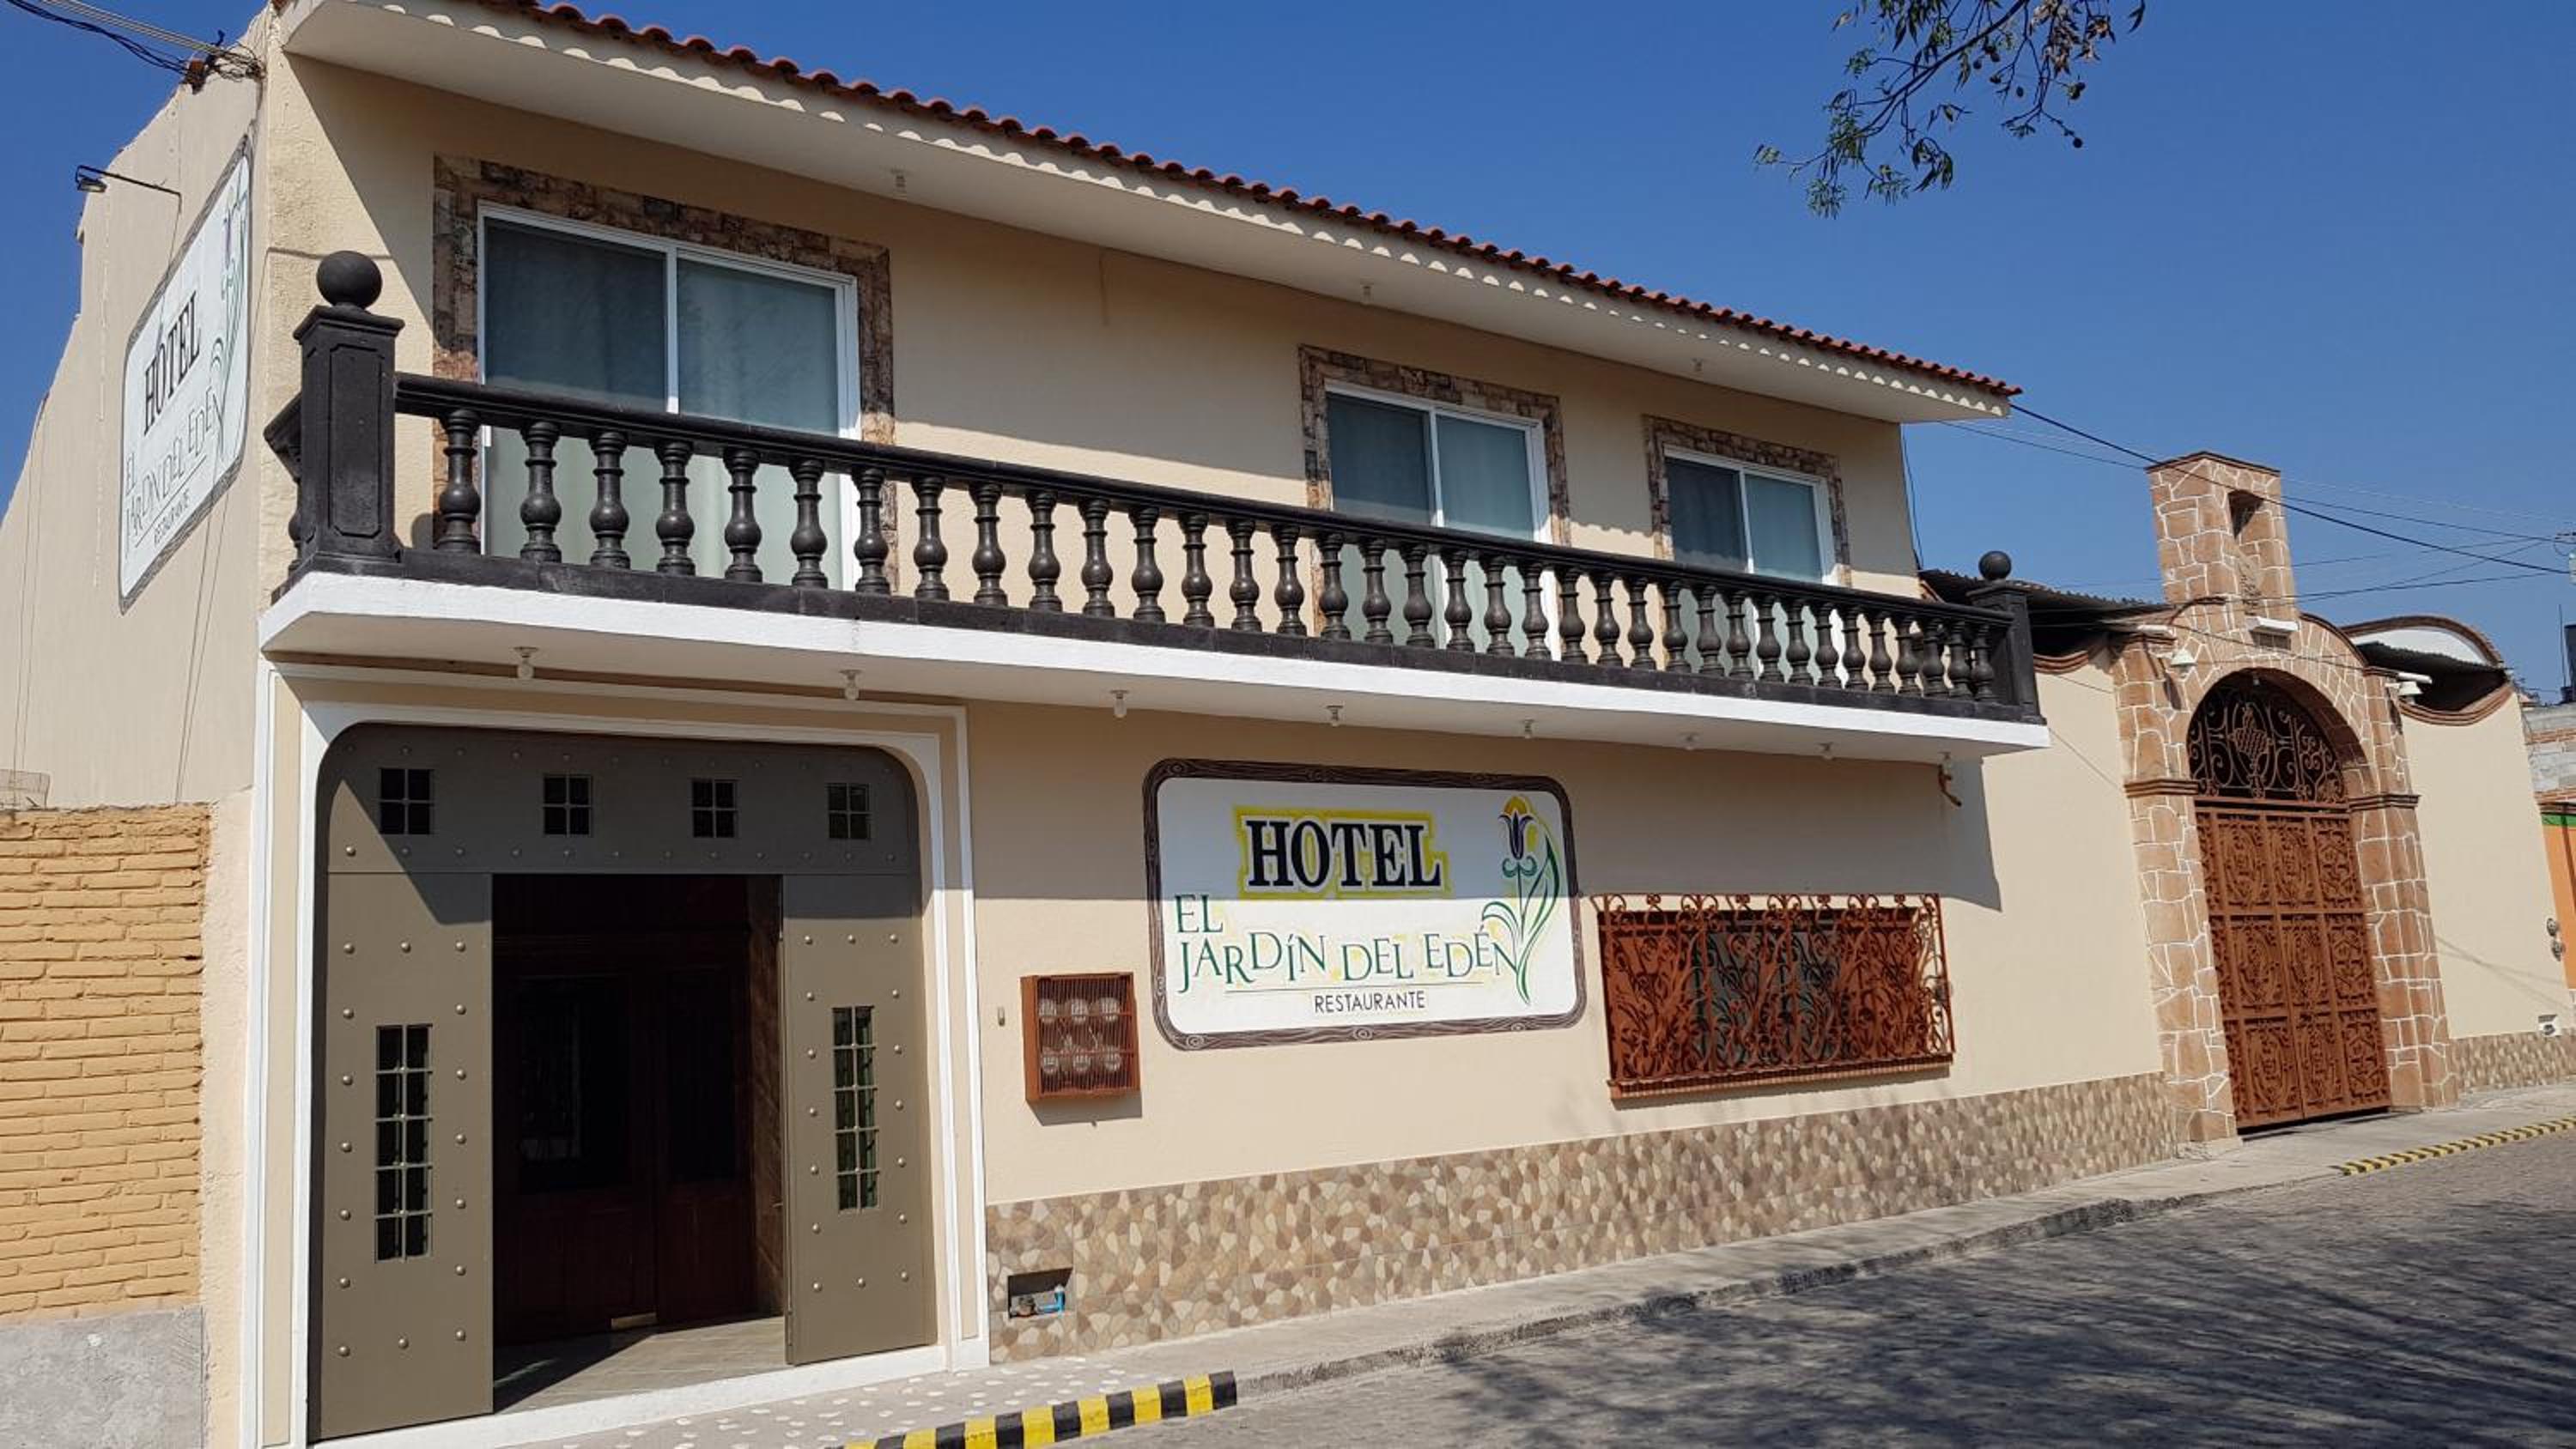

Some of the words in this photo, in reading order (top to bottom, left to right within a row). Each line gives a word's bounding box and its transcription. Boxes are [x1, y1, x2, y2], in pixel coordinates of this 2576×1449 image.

[144, 290, 201, 435] HOTEL
[1246, 820, 1442, 888] HOTEL
[1175, 894, 1224, 933] EL
[1177, 932, 1327, 993] JARDÍN
[1342, 938, 1414, 981] DEL
[1425, 925, 1519, 978] EDÉN
[1315, 991, 1426, 1014] RESTAURANTE
